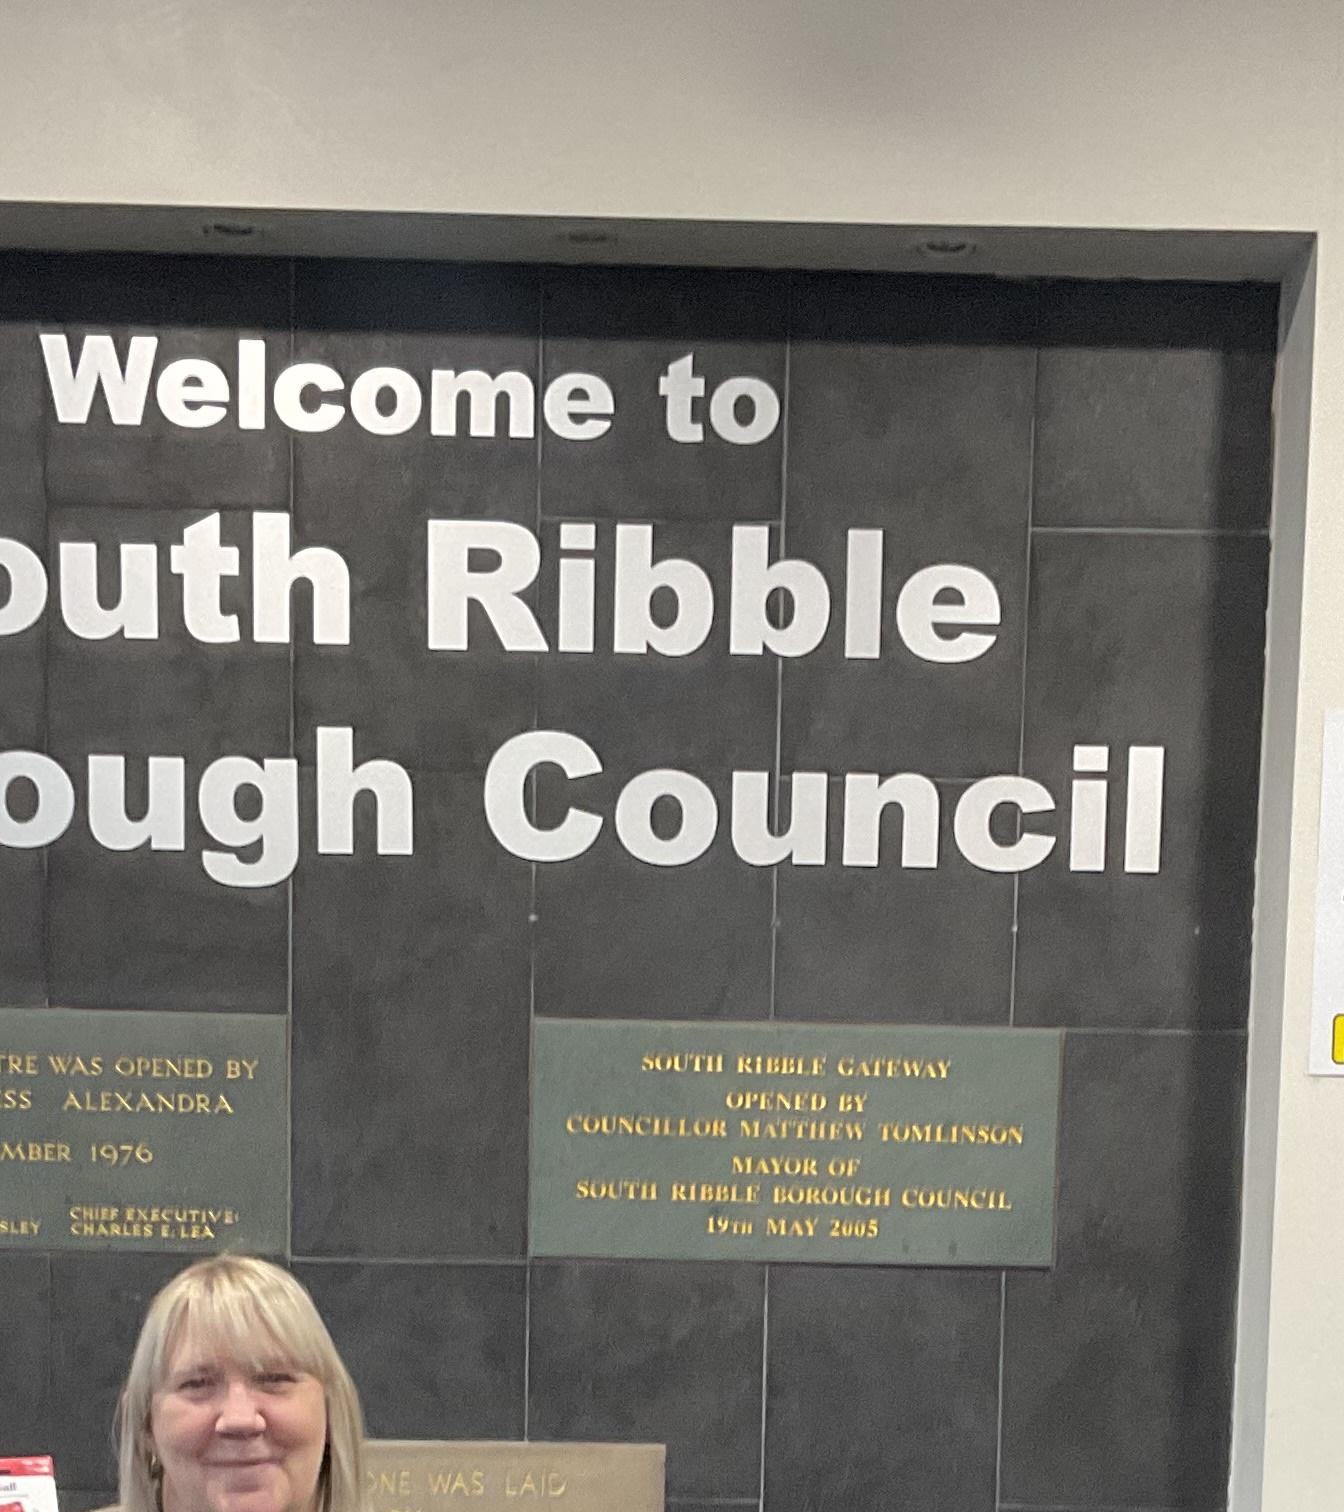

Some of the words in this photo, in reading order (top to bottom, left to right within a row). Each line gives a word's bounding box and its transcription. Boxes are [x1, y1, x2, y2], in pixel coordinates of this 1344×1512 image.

[39, 331, 615, 441] Welcome
[660, 354, 781, 448] to
[425, 518, 1003, 663] Ribble
[483, 729, 1165, 875] Council
[48, 1054, 104, 1077] WAS
[114, 1055, 213, 1079] OPENED
[225, 1058, 258, 1081] BY
[641, 1054, 724, 1075] SOUTH
[736, 1055, 827, 1077] RIBBLE
[837, 1057, 952, 1080] GATEWAY
[62, 1091, 234, 1115] ALEXANDRA
[725, 1092, 827, 1112] OPENED
[838, 1093, 868, 1114] BY
[565, 1114, 728, 1139] COUNCILLOR
[739, 1119, 865, 1142] MATTHEW
[878, 1123, 1024, 1145] TOMLINSON
[90, 1142, 154, 1165] 1976
[731, 1156, 819, 1177] MAYOR
[828, 1158, 862, 1178] OF
[575, 1180, 658, 1201] SOUTH
[671, 1182, 760, 1204] RIBBLE
[772, 1186, 892, 1208] BOROUGH
[901, 1189, 1013, 1211] COUNCIL
[69, 1206, 120, 1222] CHIEF
[70, 1222, 153, 1238] CHARLES
[180, 1224, 216, 1239] LEA
[766, 1217, 819, 1238] MAY
[829, 1219, 879, 1239] 2005
[428, 1471, 485, 1497] WAS
[506, 1470, 568, 1496] LAID
